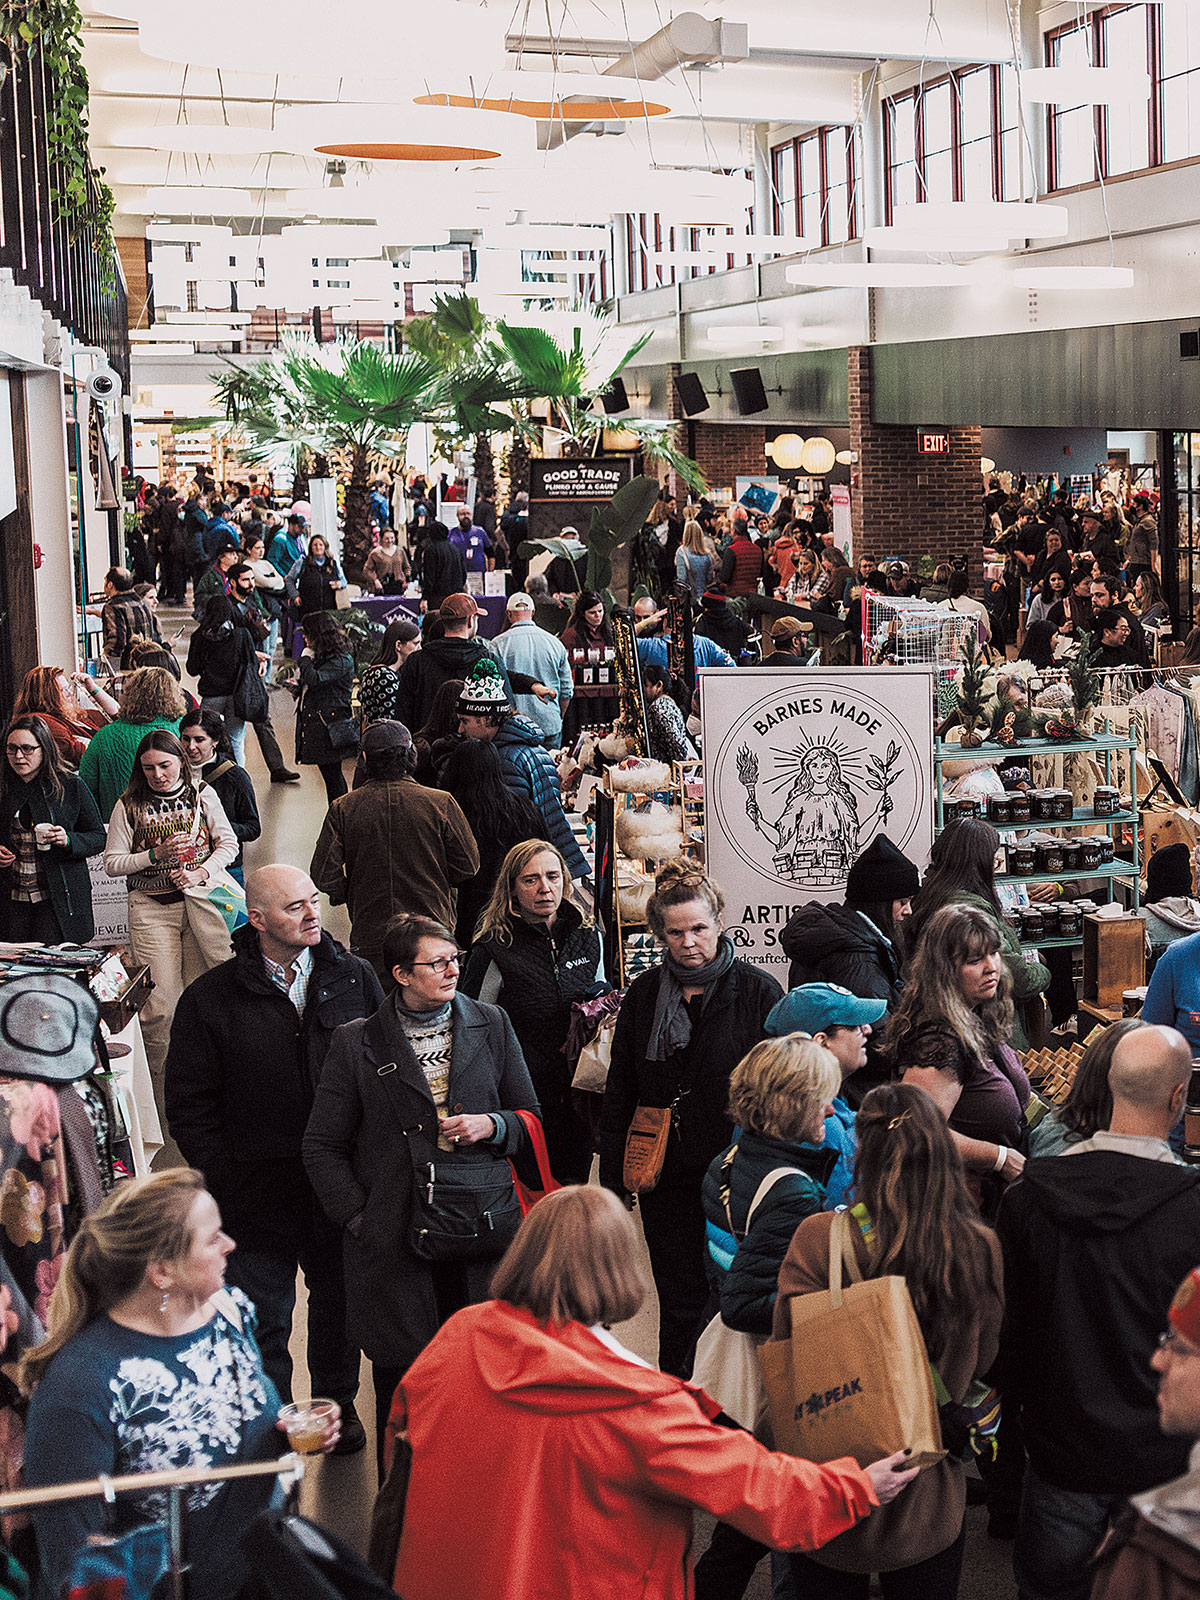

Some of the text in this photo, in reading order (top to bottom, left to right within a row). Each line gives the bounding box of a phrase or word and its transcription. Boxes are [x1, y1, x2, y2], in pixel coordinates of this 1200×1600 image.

[923, 435, 945, 451] EXIT
[543, 469, 621, 483] GOOD TRADE
[545, 483, 570, 491] PLINKO
[572, 483, 586, 491] FOR
[594, 482, 618, 490] CAUSE
[466, 703, 492, 712] HEADY
[753, 698, 883, 736] BARNES MADE
[725, 926, 756, 947] &
[572, 956, 591, 967] VAIL
